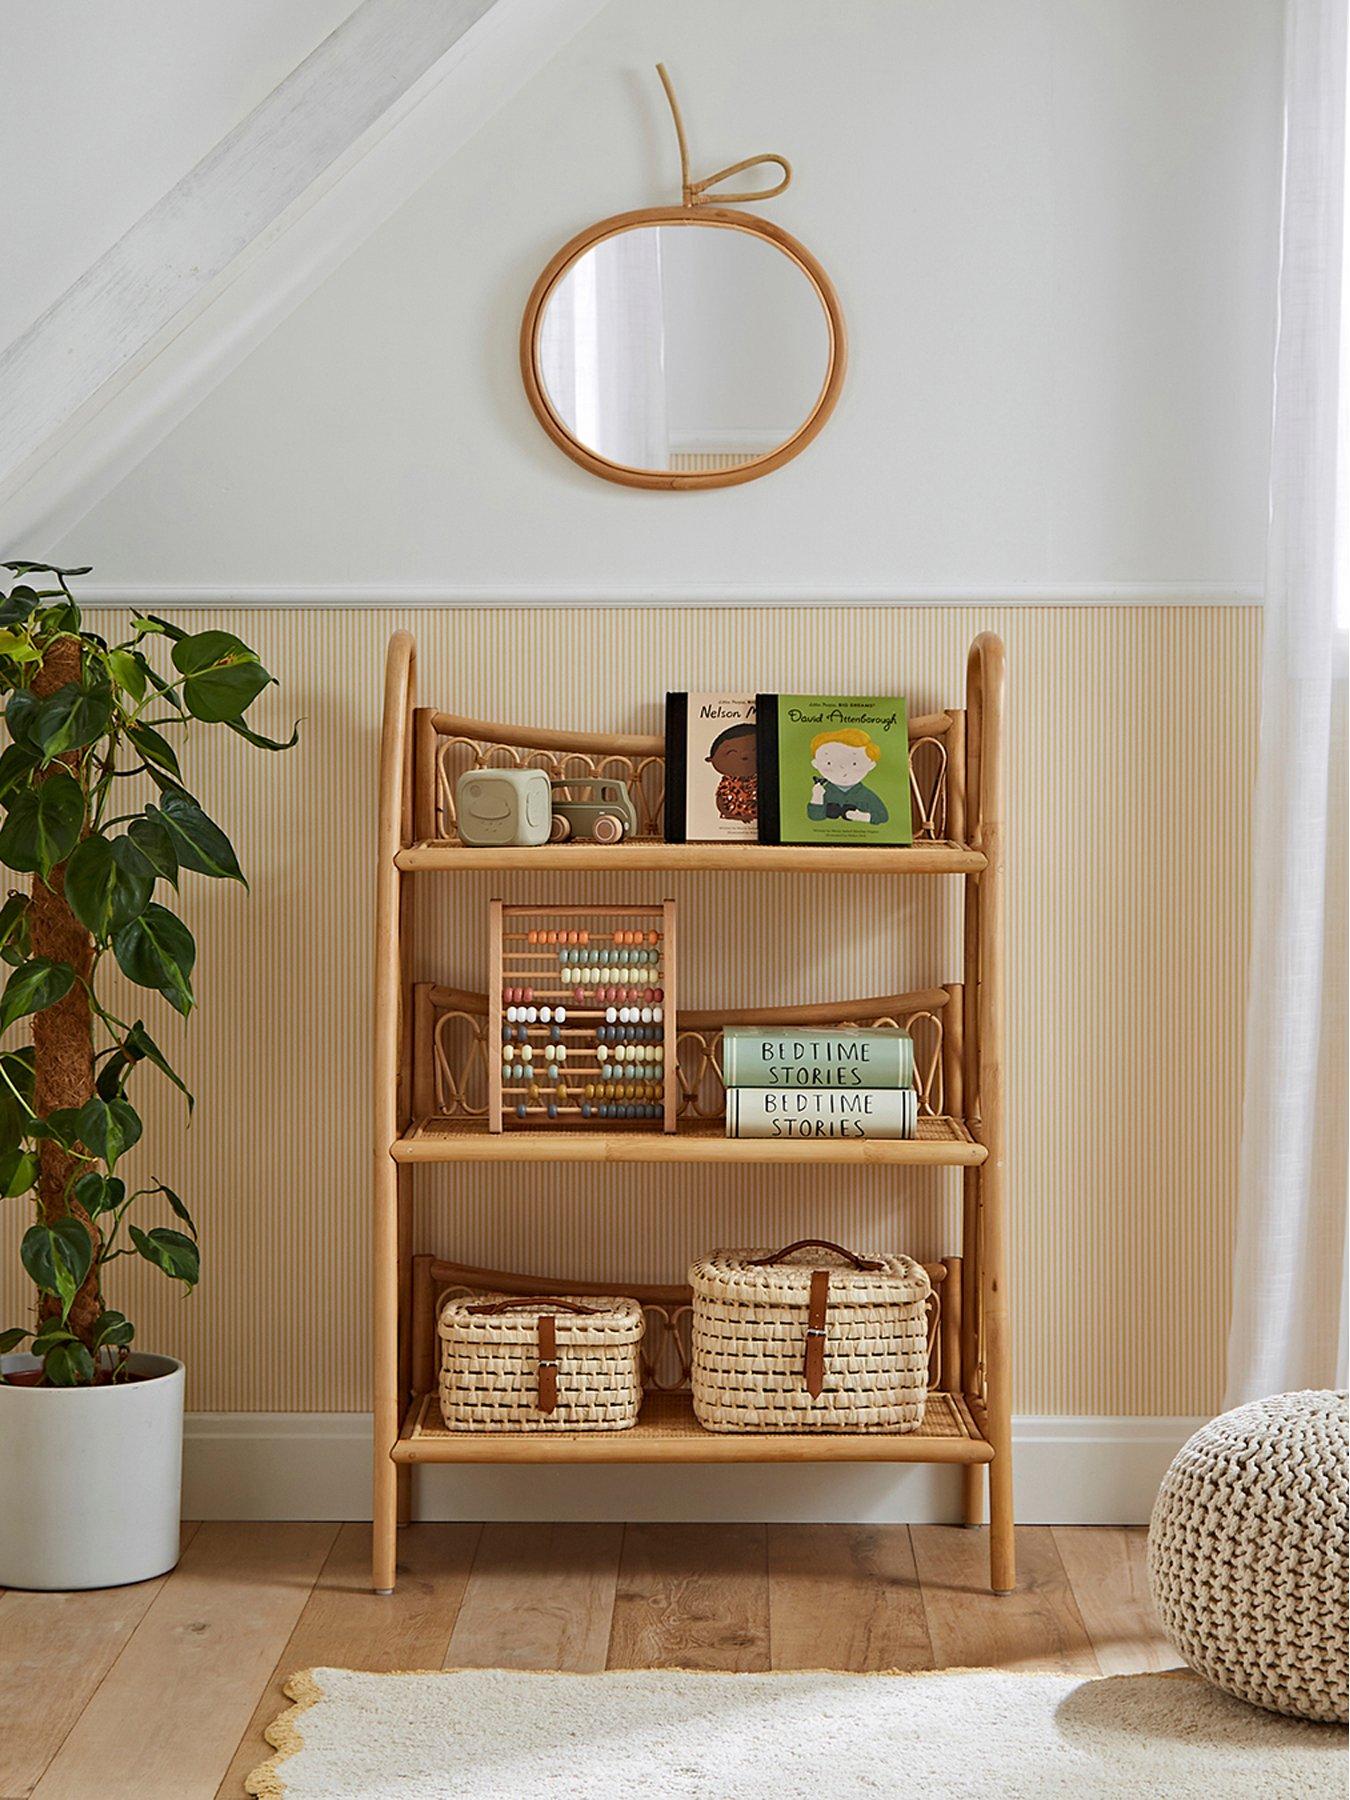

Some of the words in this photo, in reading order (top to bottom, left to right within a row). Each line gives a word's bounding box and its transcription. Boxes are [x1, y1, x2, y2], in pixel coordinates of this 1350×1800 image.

[700, 704, 741, 719] Nelson
[787, 709, 823, 723] David
[826, 709, 897, 731] Attenborough
[762, 1042, 870, 1062] BEDTIME
[769, 1066, 862, 1086] STORIES
[765, 1094, 873, 1114] BEDTIME
[772, 1118, 866, 1137] STORIES
